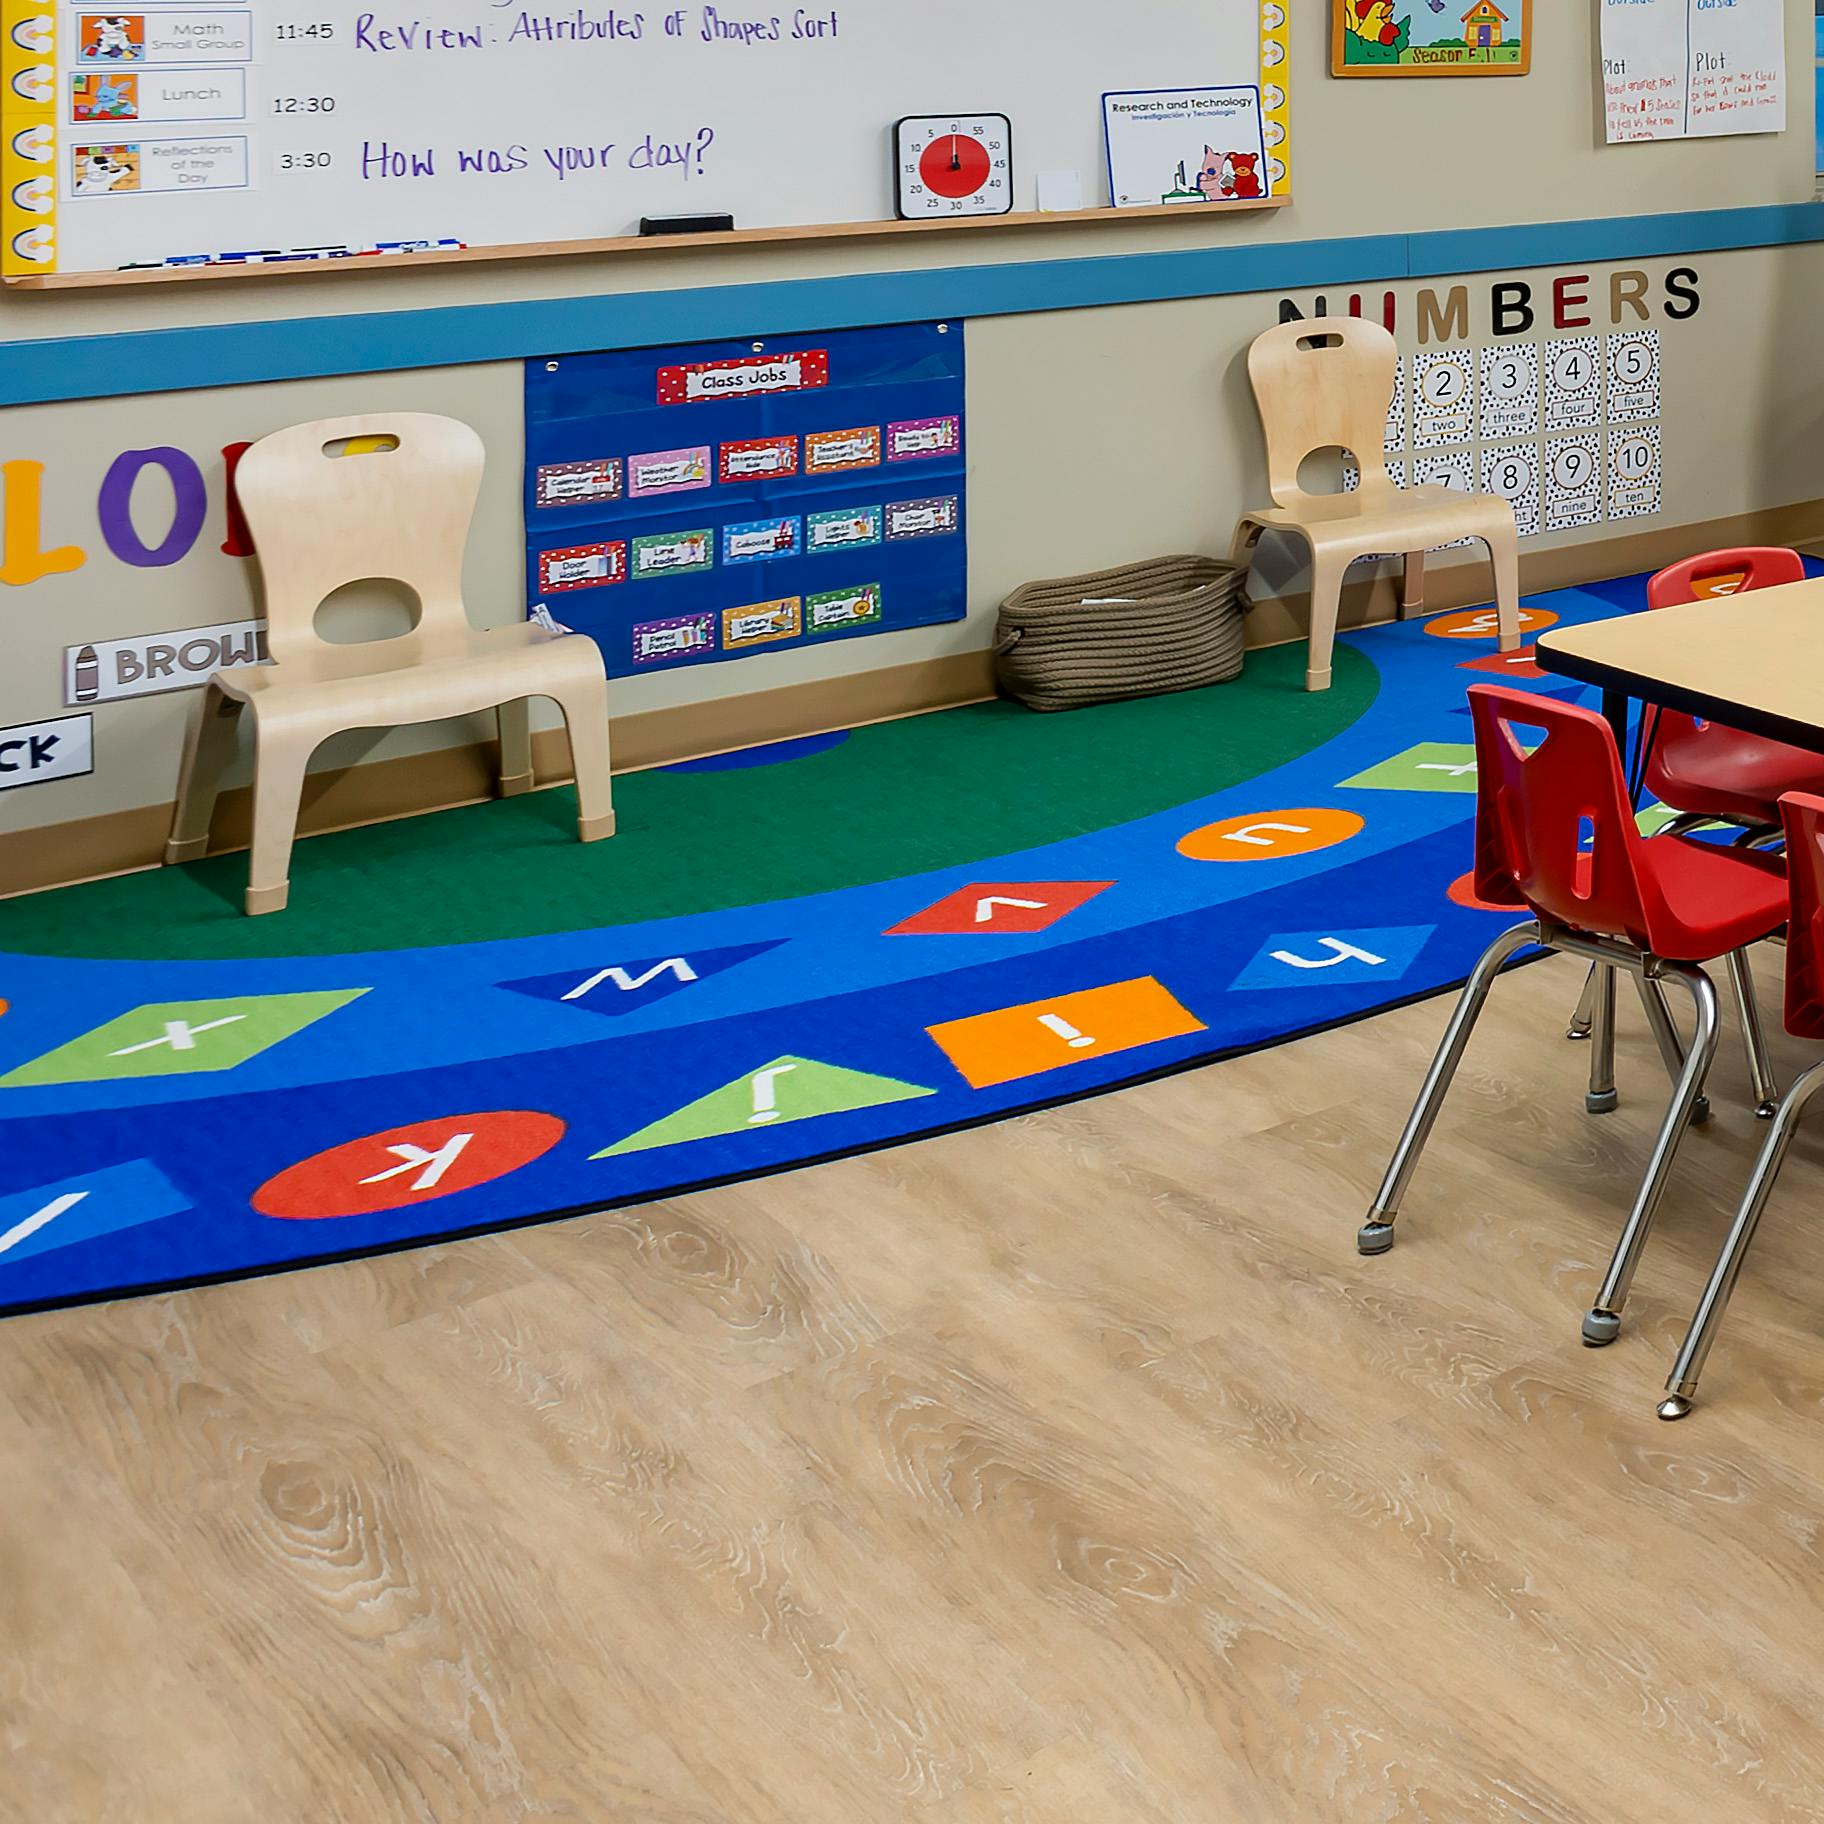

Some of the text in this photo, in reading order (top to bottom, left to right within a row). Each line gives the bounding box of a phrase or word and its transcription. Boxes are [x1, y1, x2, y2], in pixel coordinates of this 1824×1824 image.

[172, 23, 224, 36] Math
[276, 24, 334, 40] 11:45
[508, 9, 645, 43] Attributes
[700, 5, 780, 46] Shapes
[790, 9, 840, 40] Sort
[151, 39, 245, 52] Small Group
[1413, 47, 1463, 63] Season
[162, 87, 222, 101] Lunch
[273, 97, 336, 114] 12:30
[1112, 96, 1252, 113] Research and Technology
[973, 126, 984, 135] 55
[152, 143, 233, 157] Reflections
[911, 144, 921, 152] 10
[989, 141, 1000, 150] 50
[280, 152, 331, 169] 3:30
[362, 127, 715, 182] How was your day?
[171, 159, 215, 170] of the
[905, 164, 915, 173] 15
[994, 160, 1005, 168] 45
[178, 173, 208, 185] Day
[989, 179, 1001, 188] 40
[910, 185, 922, 194] 20
[927, 199, 938, 208] 25
[950, 201, 962, 210] 30
[973, 196, 985, 205] 35
[1626, 349, 1641, 374] 5
[1564, 356, 1581, 381] 4
[701, 368, 788, 389] Class Jobs
[1502, 363, 1517, 389] 3
[1435, 370, 1452, 397] 2
[1623, 393, 1644, 408] five
[1561, 400, 1586, 415] four
[1493, 408, 1526, 424] three
[1432, 418, 1456, 431] two
[1622, 446, 1649, 471] 10
[1565, 454, 1581, 479] 9
[551, 476, 591, 486] Calendar
[1503, 465, 1519, 490] 8
[1625, 490, 1644, 504] ten
[1560, 499, 1587, 513] nine
[736, 538, 771, 549] Caboose
[654, 546, 676, 555] Line
[562, 561, 587, 570] Door
[647, 556, 682, 566] Leader
[650, 632, 676, 643] Pencil
[648, 640, 677, 651] Patrol
